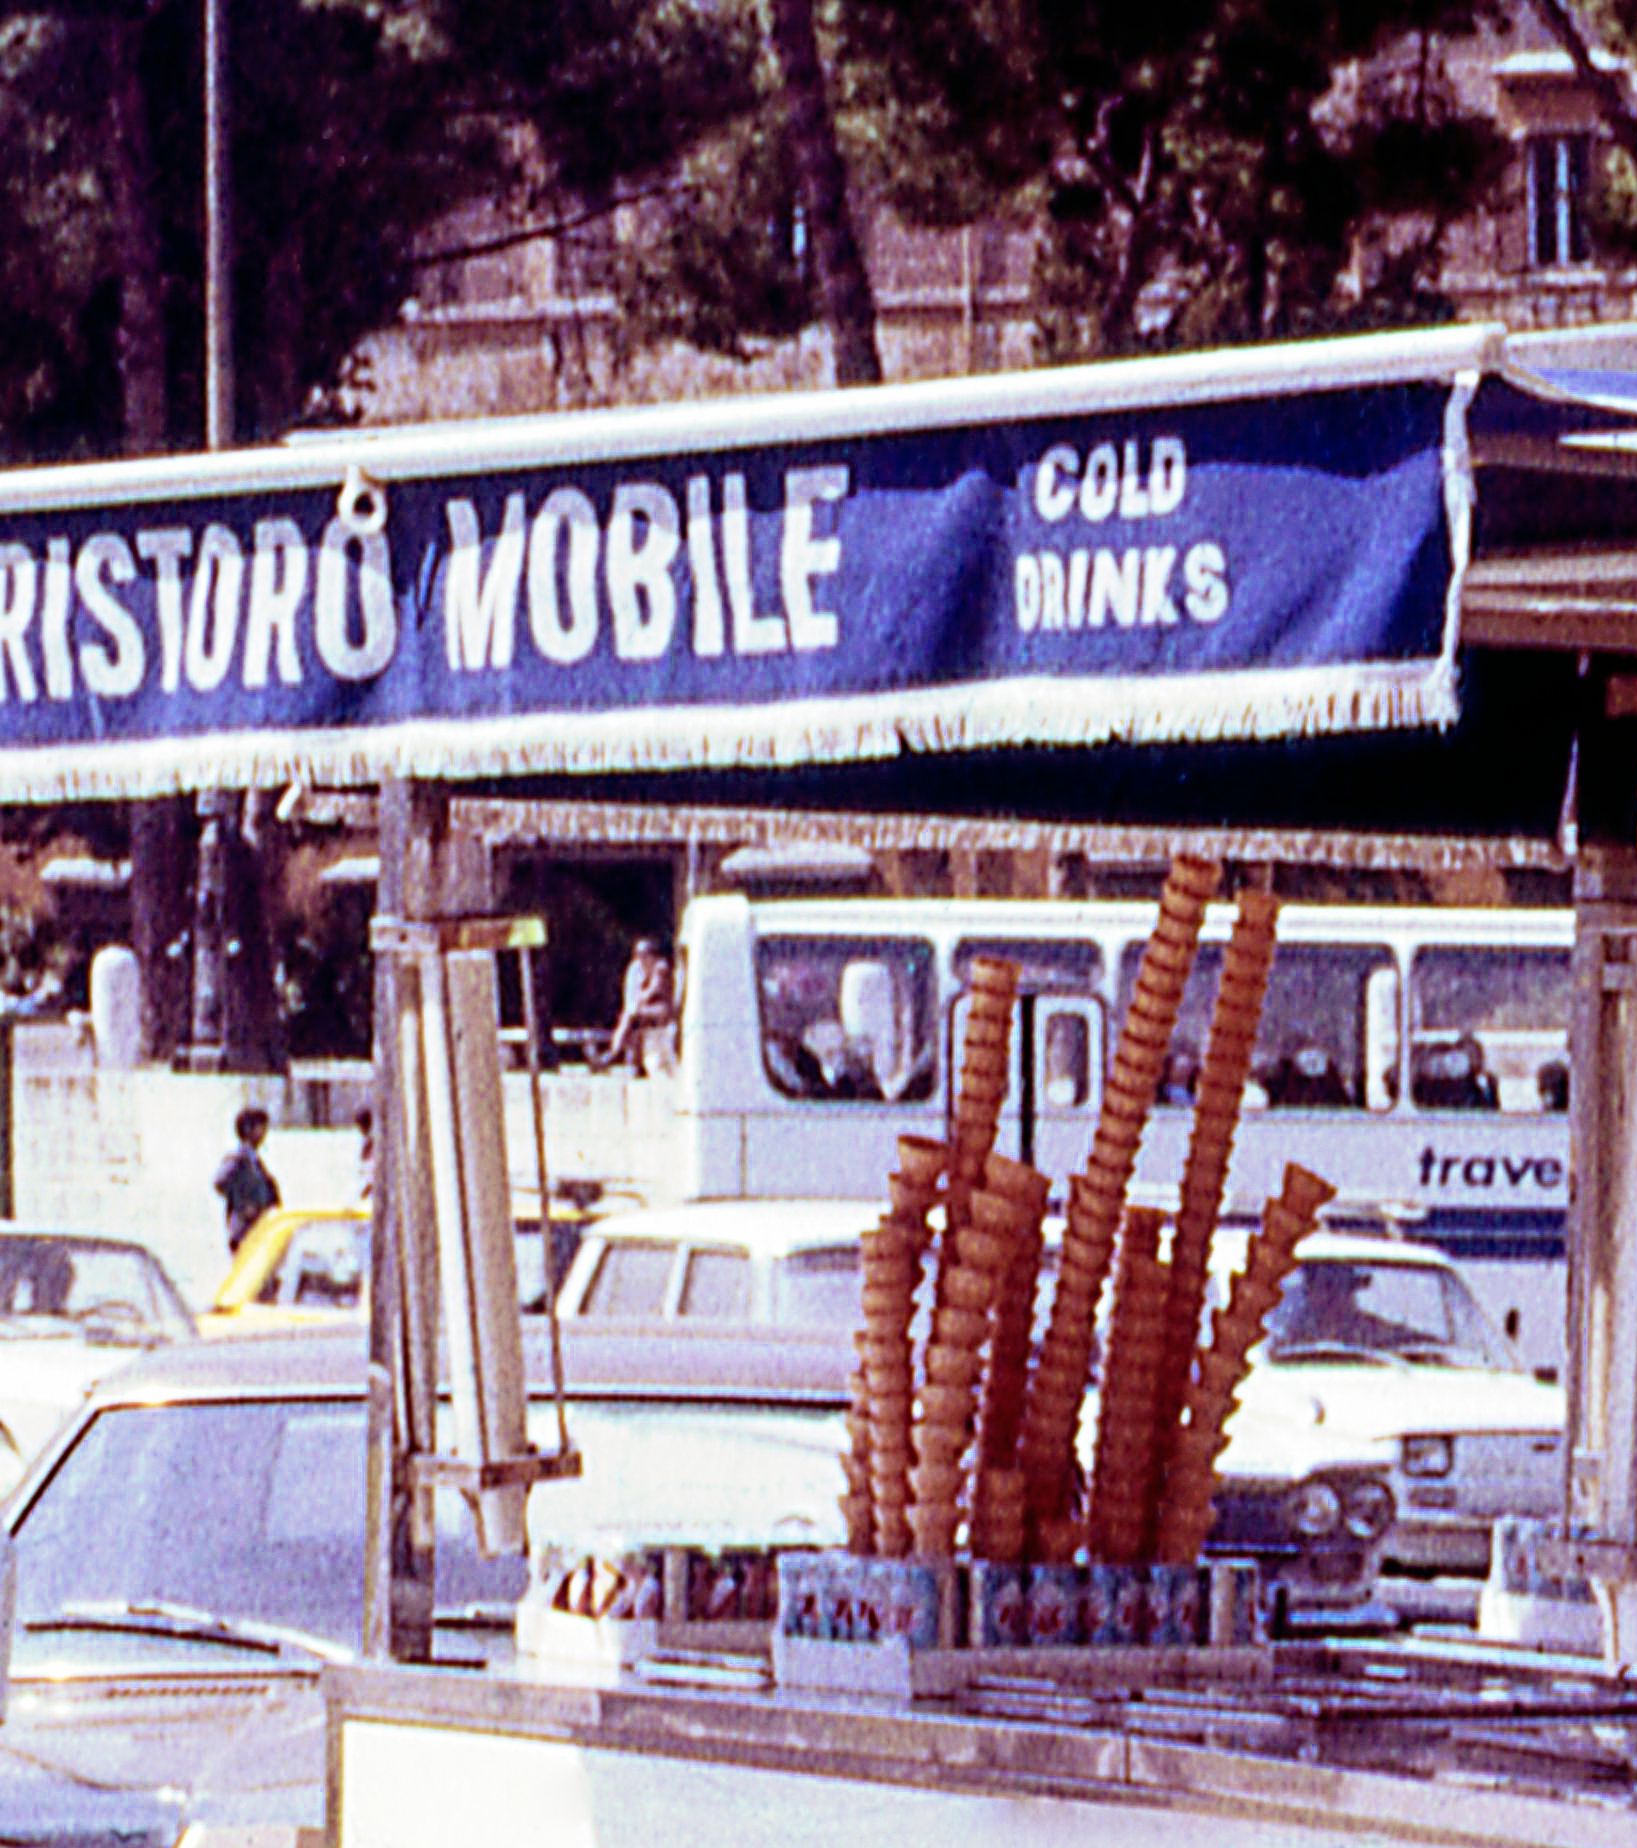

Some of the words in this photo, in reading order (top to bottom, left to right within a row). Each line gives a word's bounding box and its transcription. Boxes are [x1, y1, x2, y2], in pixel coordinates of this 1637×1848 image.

[1036, 436, 1188, 521] COLD
[0, 518, 396, 703] RISTORO
[443, 464, 848, 672] MOBILE
[1016, 542, 1228, 632] DRINKS
[1420, 1145, 1562, 1187] trave
